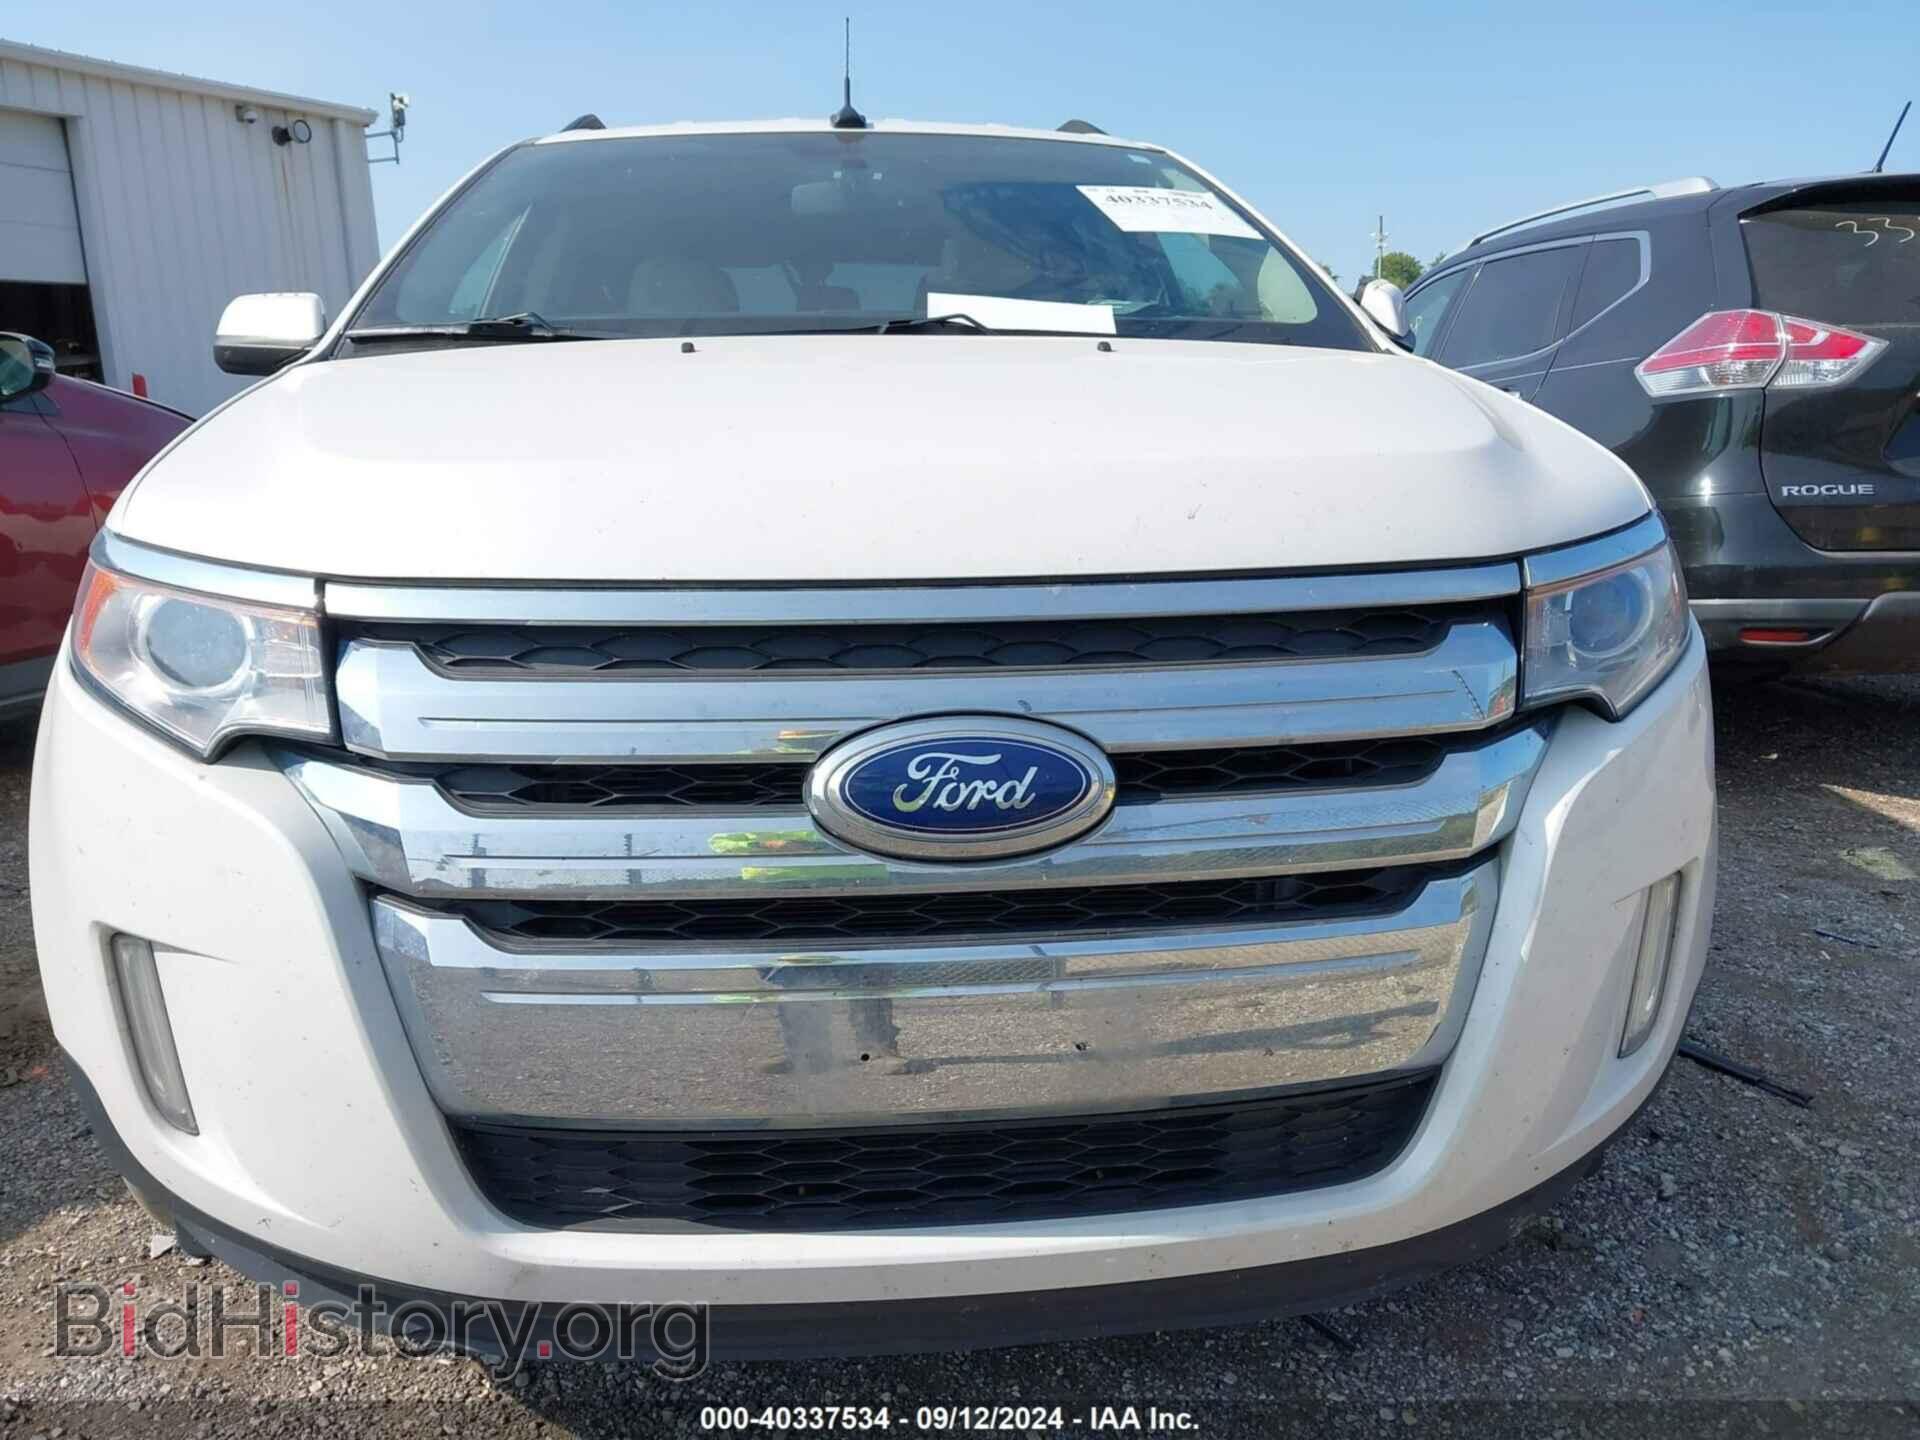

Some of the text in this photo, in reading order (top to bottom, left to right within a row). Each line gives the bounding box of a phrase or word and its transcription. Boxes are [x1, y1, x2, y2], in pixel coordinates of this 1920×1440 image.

[1834, 216, 1920, 247] 33
[1781, 484, 1875, 497] ROGUE
[892, 752, 1038, 812] Ford
